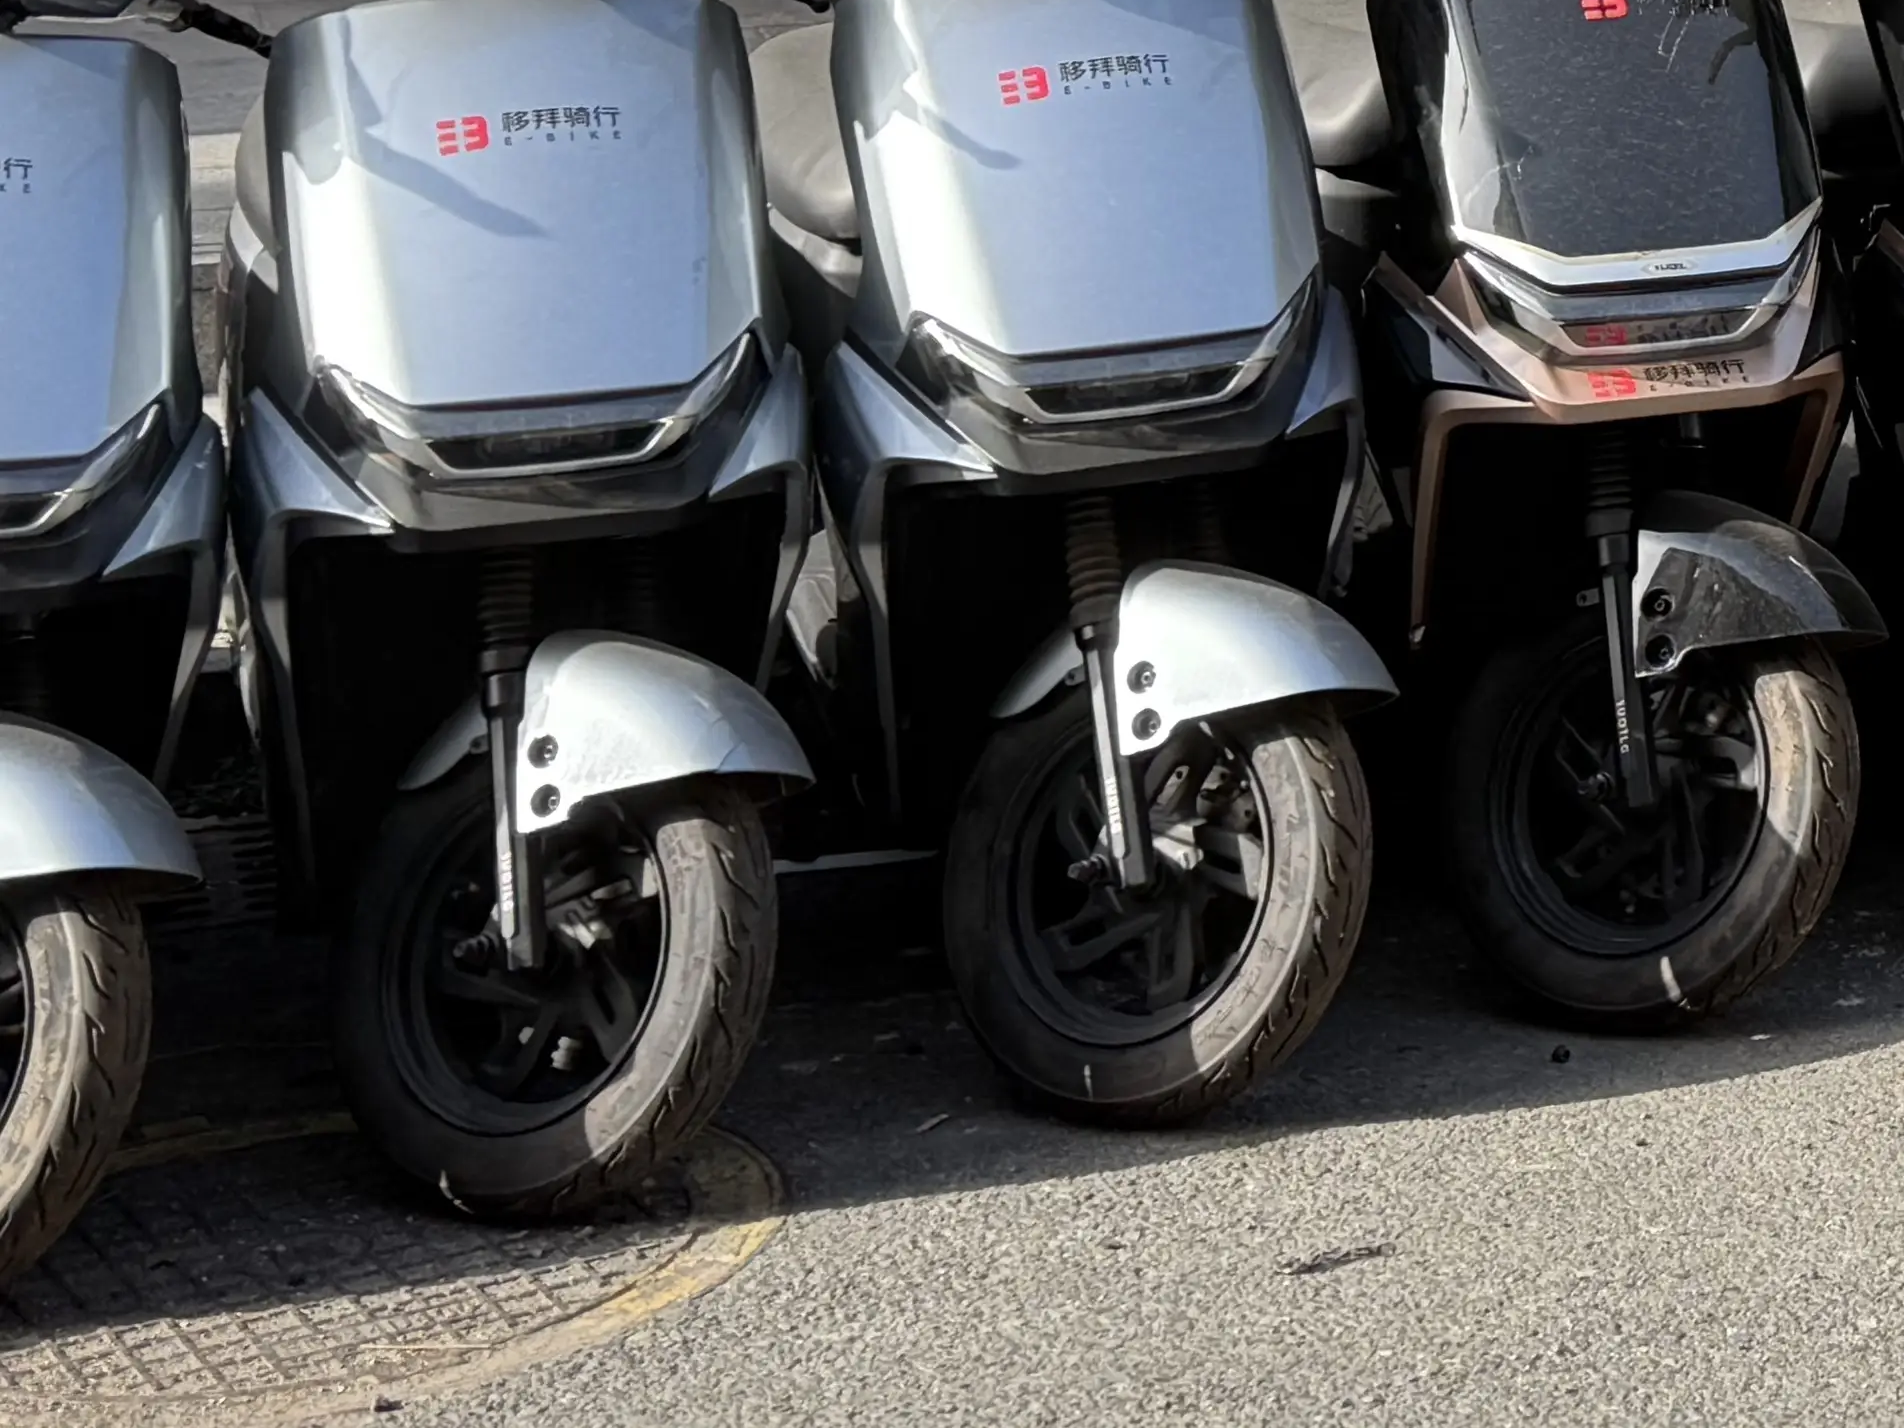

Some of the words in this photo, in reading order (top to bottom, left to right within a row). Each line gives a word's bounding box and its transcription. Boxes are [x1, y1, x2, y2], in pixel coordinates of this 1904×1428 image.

[1059, 54, 1169, 83] 移拜骑行
[501, 106, 621, 133] 移拜骑行
[2, 157, 33, 181] 行
[1644, 359, 1744, 384] 移拜骑行
